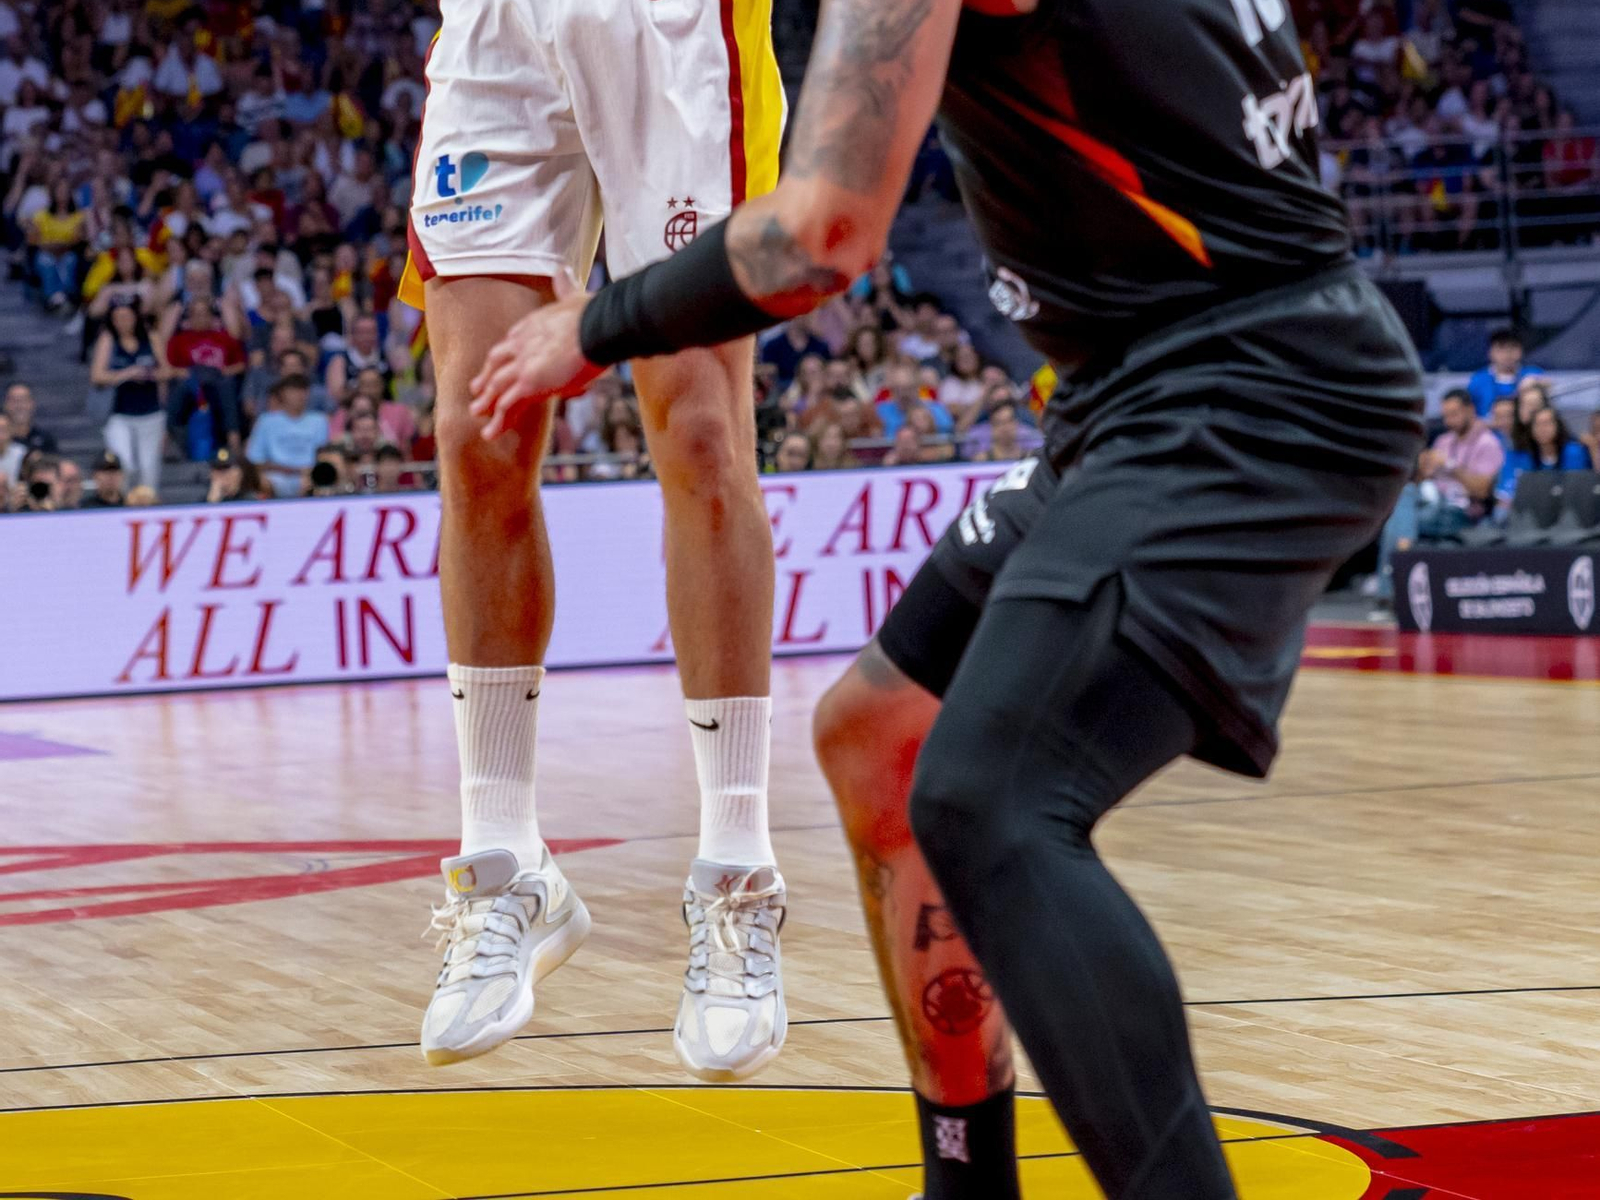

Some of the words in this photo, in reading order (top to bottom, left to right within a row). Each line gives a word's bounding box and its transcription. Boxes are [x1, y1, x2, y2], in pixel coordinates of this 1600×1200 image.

[125, 513, 268, 595] WE
[289, 505, 442, 586] AR
[114, 599, 300, 683] ALL
[335, 595, 416, 668] IN
